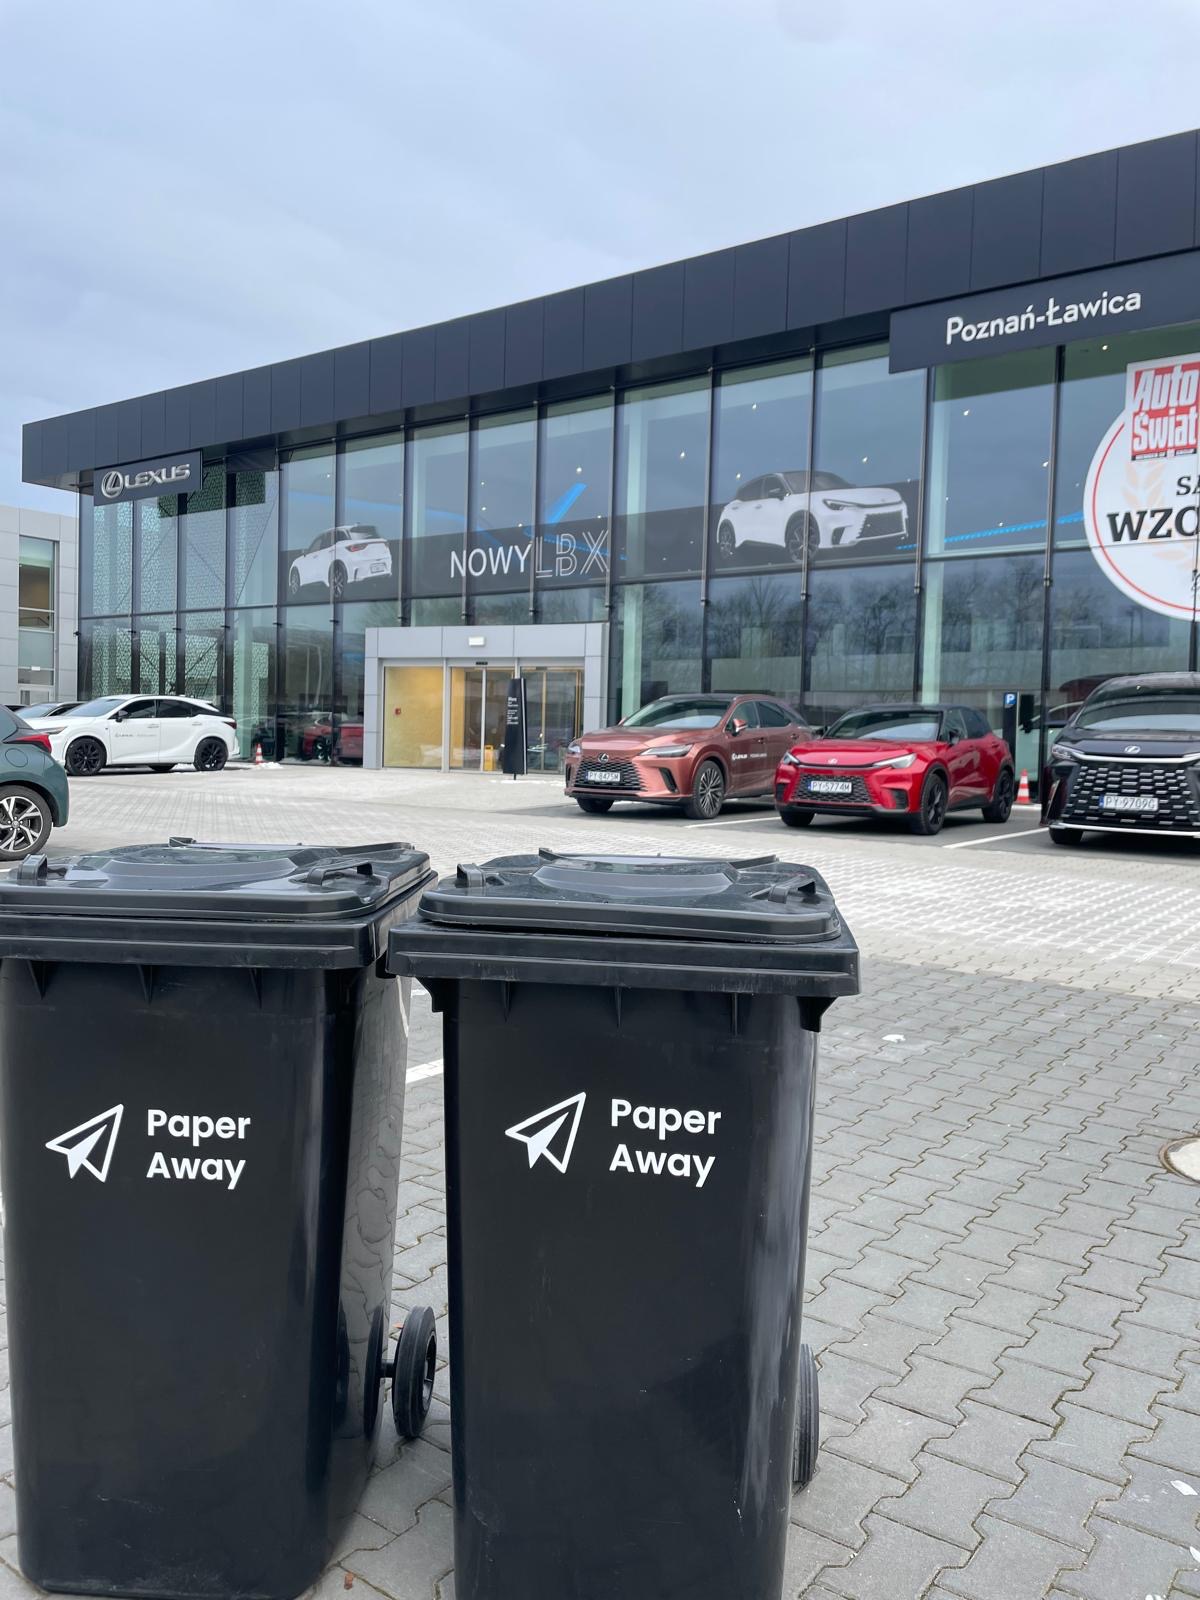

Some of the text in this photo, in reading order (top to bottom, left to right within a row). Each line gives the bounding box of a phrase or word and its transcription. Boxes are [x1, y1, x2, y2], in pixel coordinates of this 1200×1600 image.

[946, 291, 1142, 345] Poznań-Ławica
[1132, 365, 1200, 411] Auto
[1132, 406, 1198, 452] Świat
[124, 463, 191, 489] LEXUS
[450, 530, 609, 579] NOWY LBX
[147, 1109, 251, 1147] Paper
[611, 1098, 722, 1141] Paper
[146, 1151, 246, 1190] Away
[609, 1143, 716, 1188] Away
